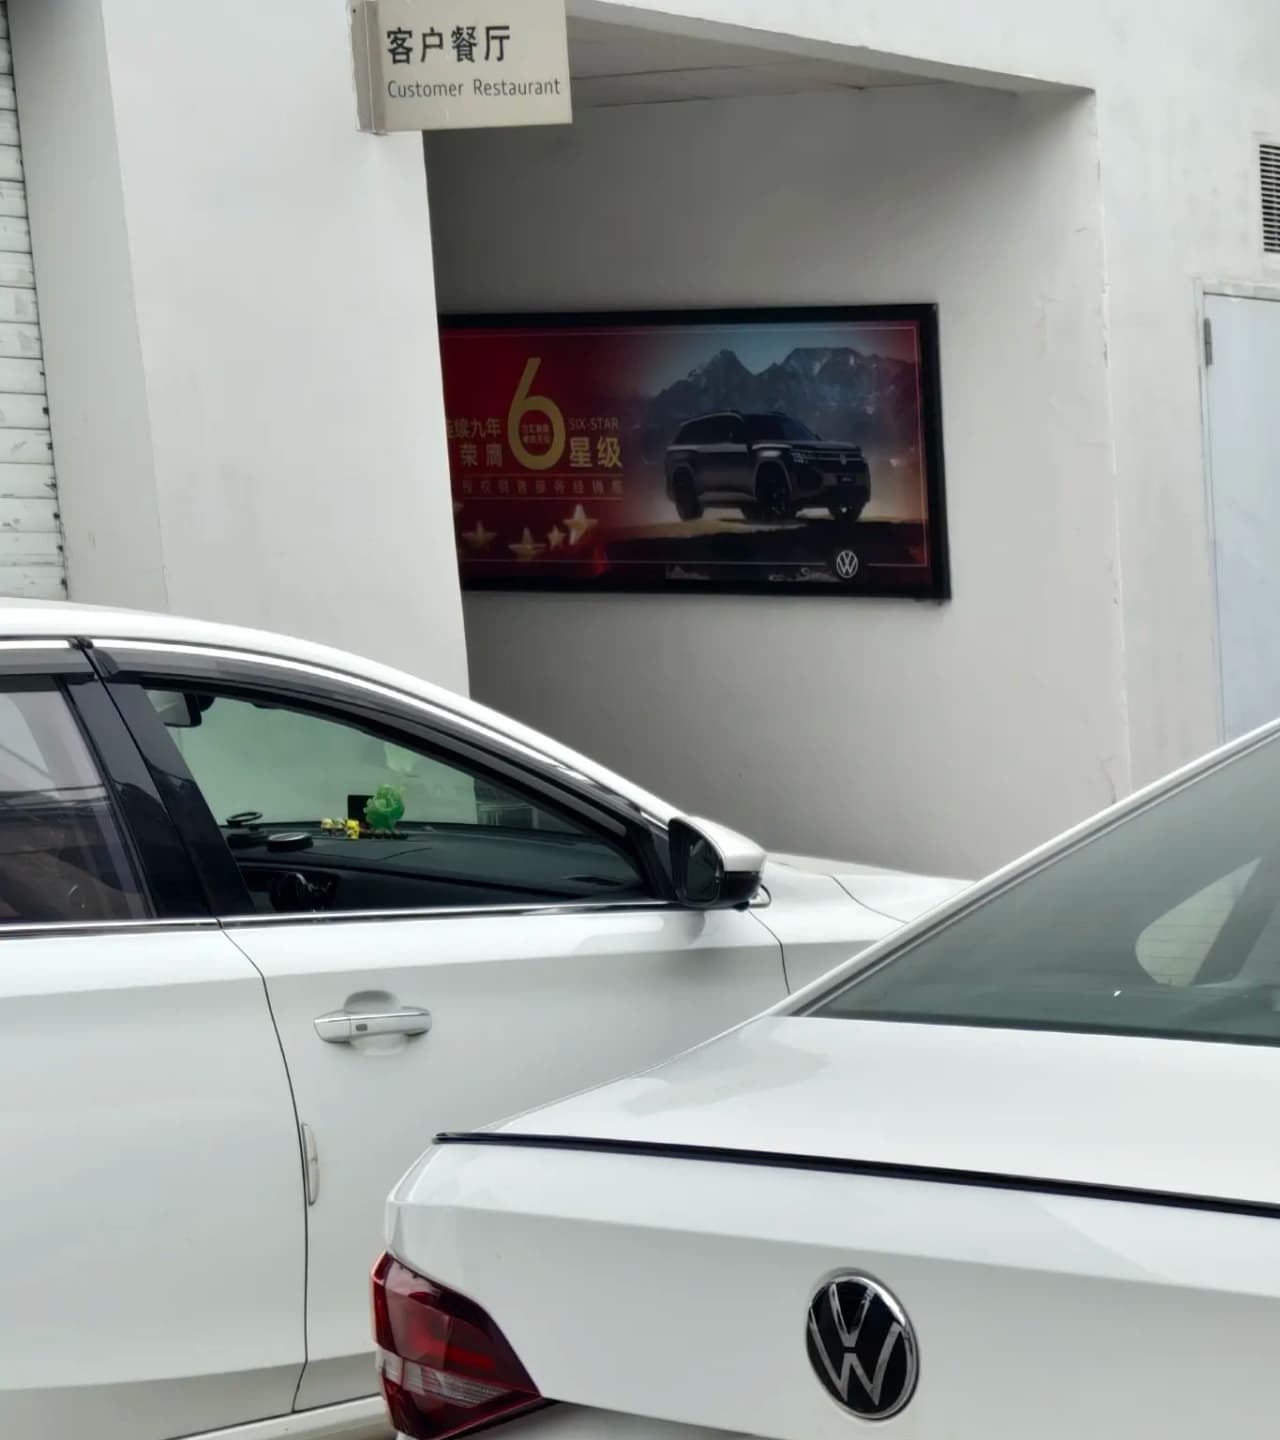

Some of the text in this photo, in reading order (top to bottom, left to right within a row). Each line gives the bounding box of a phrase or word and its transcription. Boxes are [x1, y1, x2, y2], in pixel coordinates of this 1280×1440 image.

[386, 25, 511, 65] 客户餐厅
[387, 78, 561, 99] Customer Restaurant
[507, 356, 567, 471] 6
[568, 416, 620, 433] SIX-STAR
[569, 436, 623, 468] 星级
